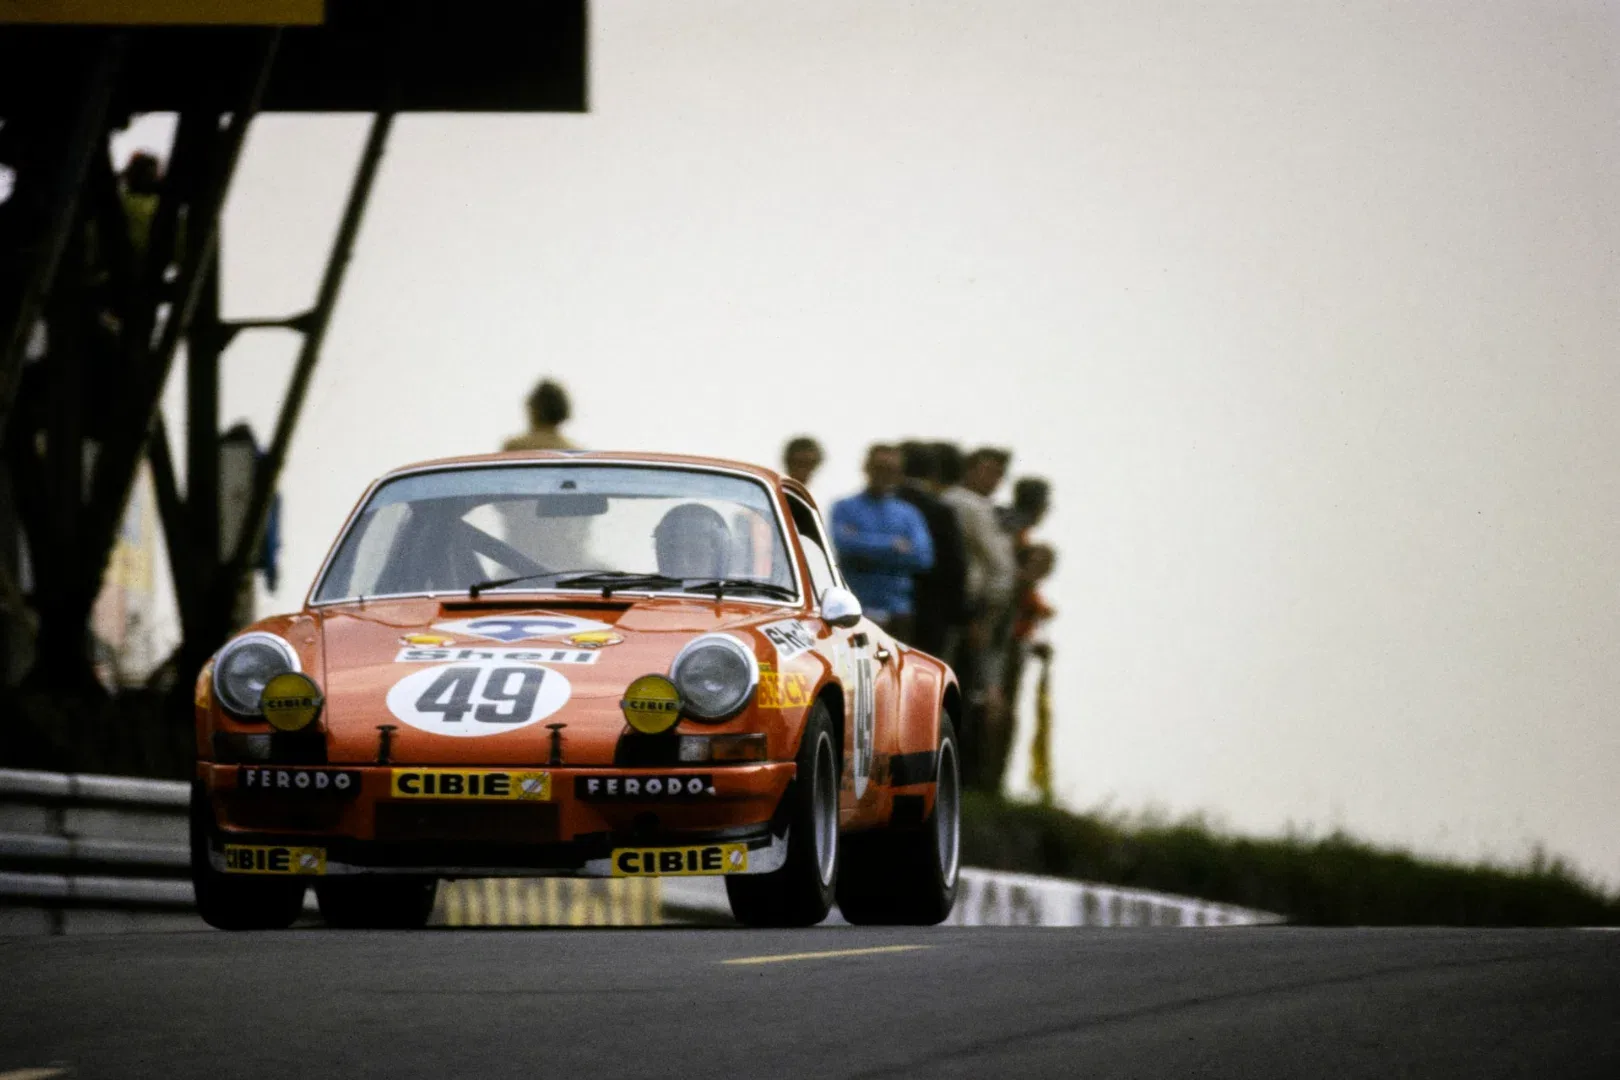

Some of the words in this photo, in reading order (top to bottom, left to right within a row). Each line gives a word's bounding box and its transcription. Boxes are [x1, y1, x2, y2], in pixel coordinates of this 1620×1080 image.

[404, 649, 592, 662] Shell
[414, 667, 546, 723] 49
[246, 769, 351, 789] FERODO
[587, 777, 703, 796] FERODO
